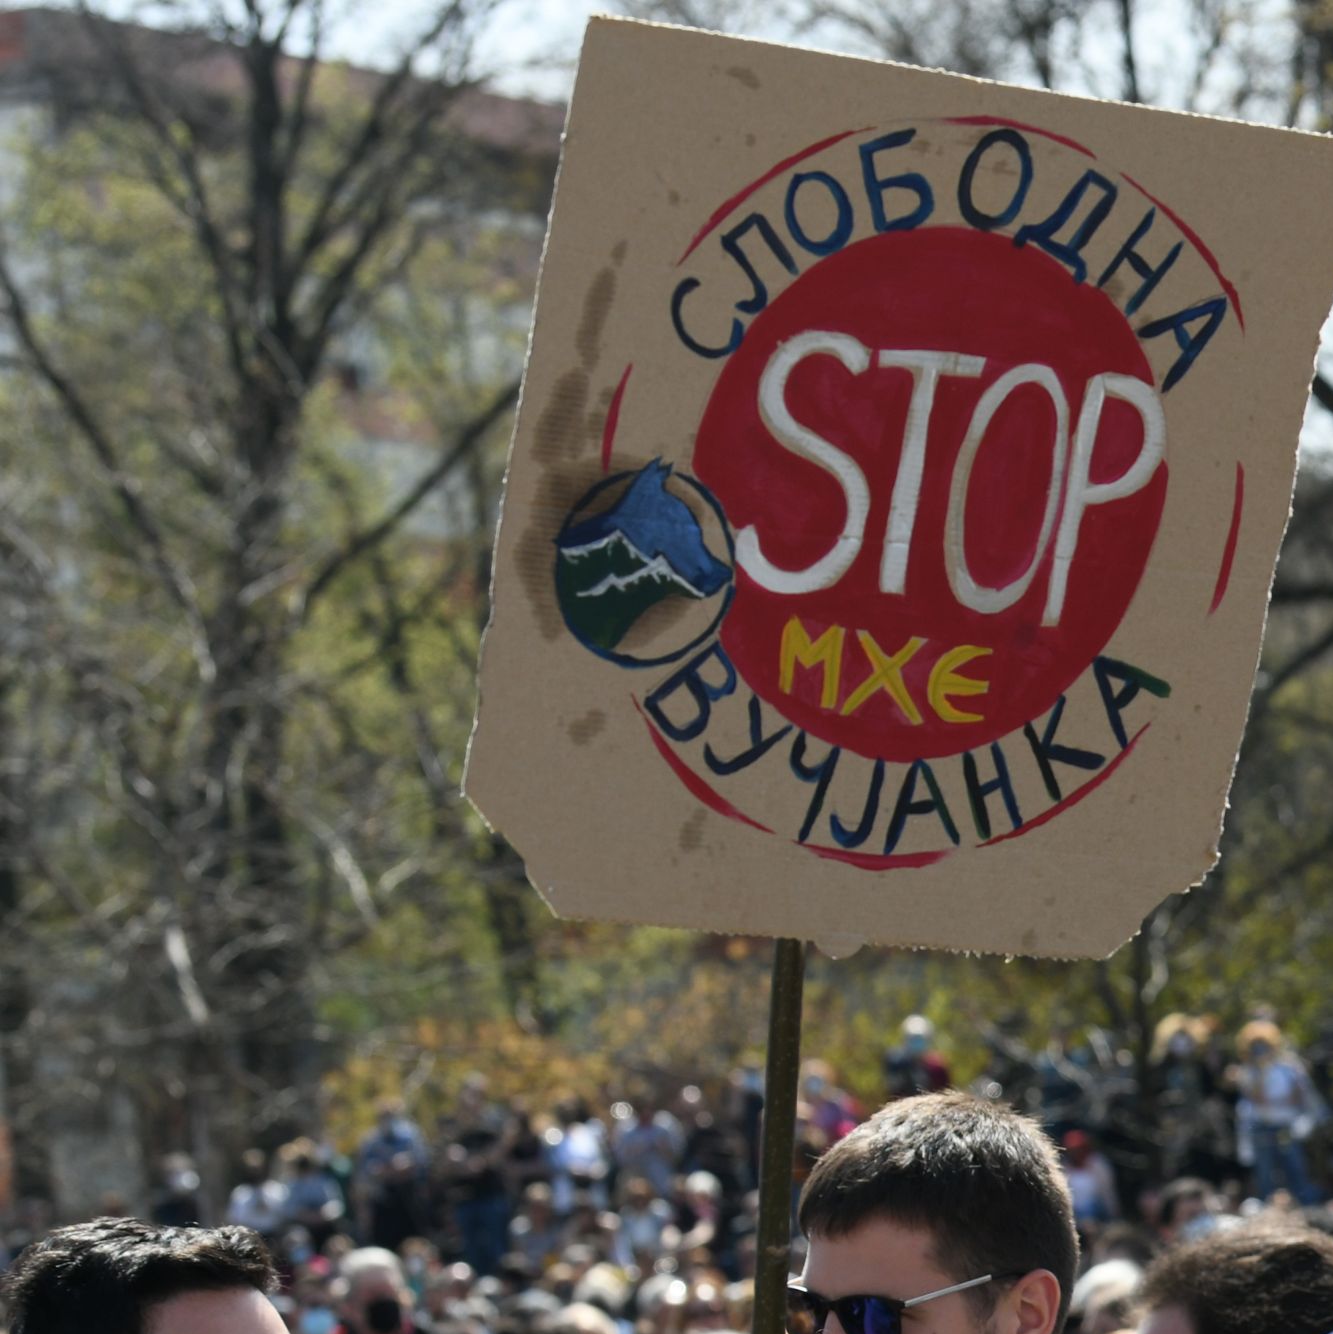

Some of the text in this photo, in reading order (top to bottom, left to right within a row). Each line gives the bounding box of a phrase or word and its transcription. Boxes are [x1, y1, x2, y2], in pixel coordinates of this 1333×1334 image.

[671, 127, 1227, 393] СЛОБОДНА
[735, 329, 1167, 627] STOP
[643, 640, 1171, 855] ВУЧЈАНКА
[779, 614, 994, 724] МХЕ
